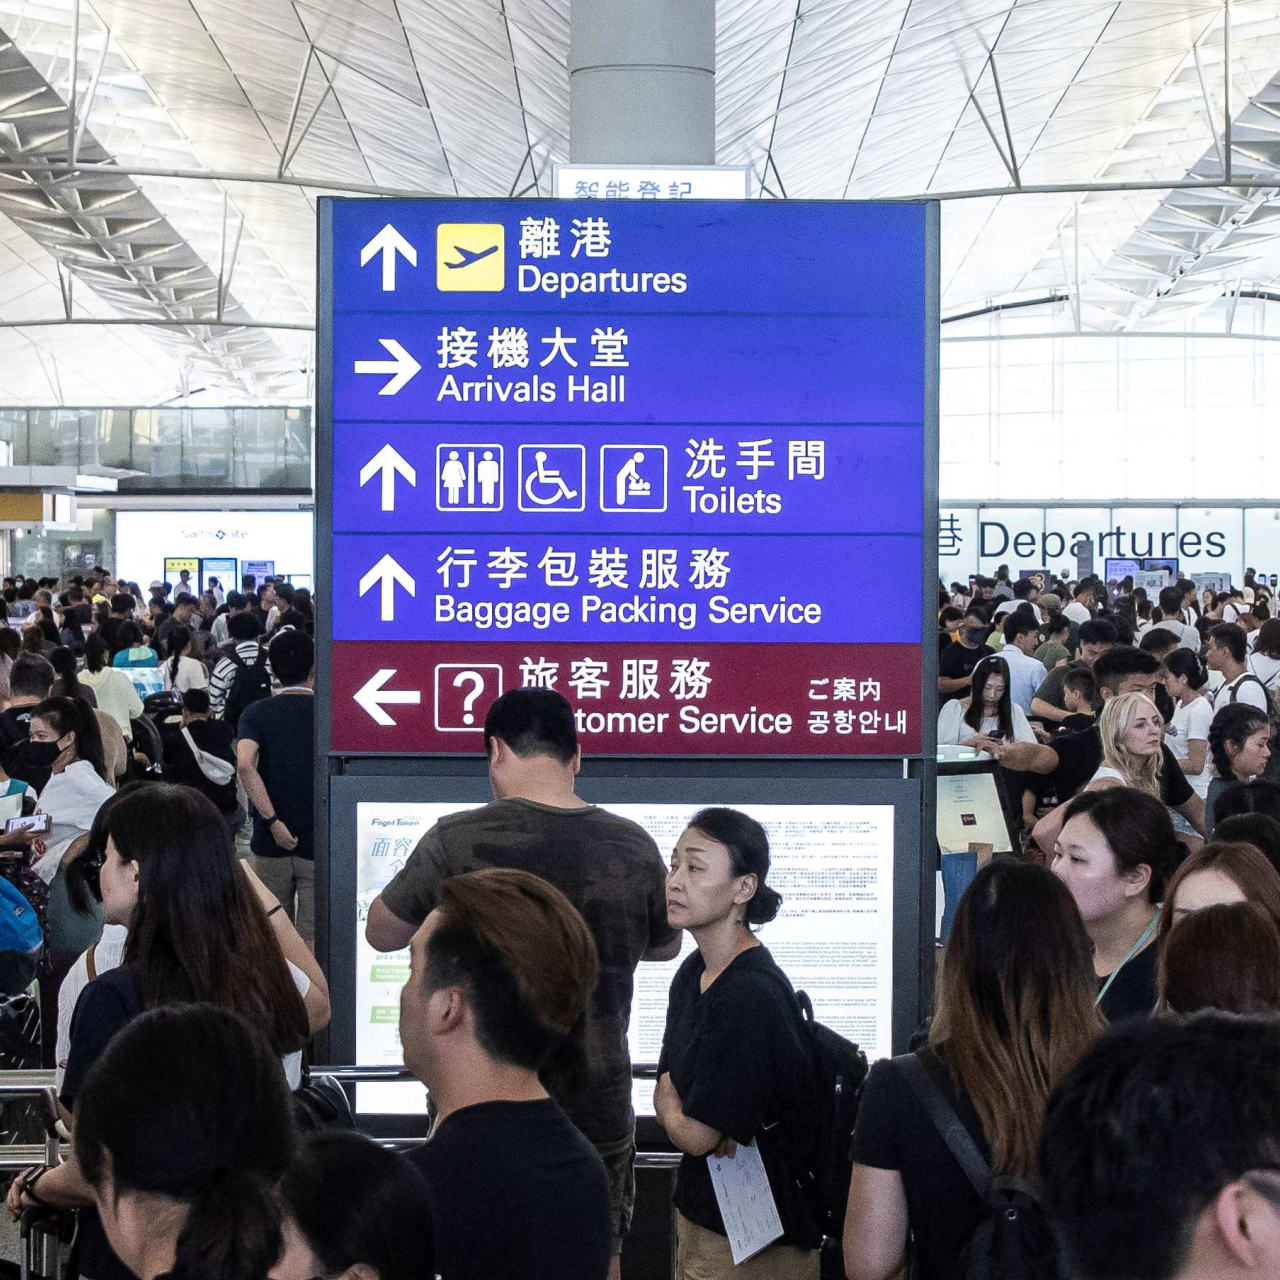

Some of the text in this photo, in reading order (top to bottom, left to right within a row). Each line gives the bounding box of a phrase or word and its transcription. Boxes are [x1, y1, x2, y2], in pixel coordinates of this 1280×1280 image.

[519, 217, 612, 259] 離港
[519, 265, 687, 298] Departures
[437, 326, 630, 369] 接機大堂
[437, 375, 625, 403] Arrivals Hall
[684, 438, 825, 481] 洗手間
[682, 486, 782, 514] Toilets
[980, 522, 1227, 567] Departures
[437, 546, 731, 590] 行李包裝服務
[435, 596, 822, 629] Baggage Packing Service
[519, 656, 713, 700] 旅客服務
[808, 677, 881, 702] ご案内
[575, 705, 793, 734] tomer Service
[807, 709, 907, 735] 공항안내
